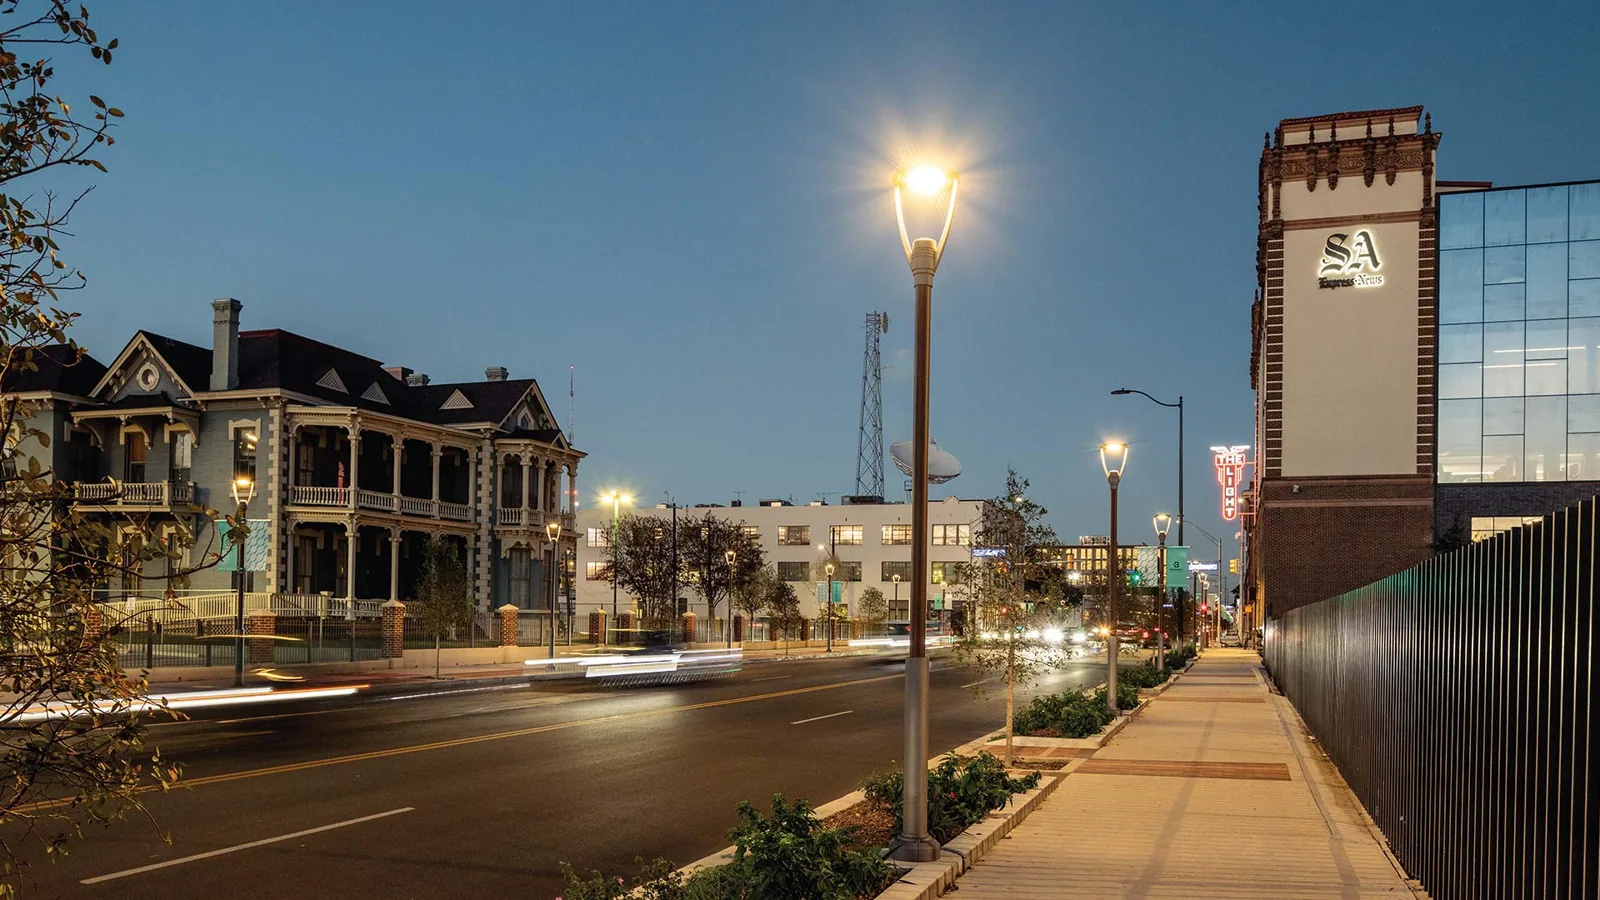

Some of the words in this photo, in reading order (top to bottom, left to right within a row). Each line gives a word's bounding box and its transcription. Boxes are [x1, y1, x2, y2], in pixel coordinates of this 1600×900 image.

[1320, 231, 1380, 275] SA
[1218, 455, 1243, 464] THE
[1225, 466, 1235, 517] LIGHT
